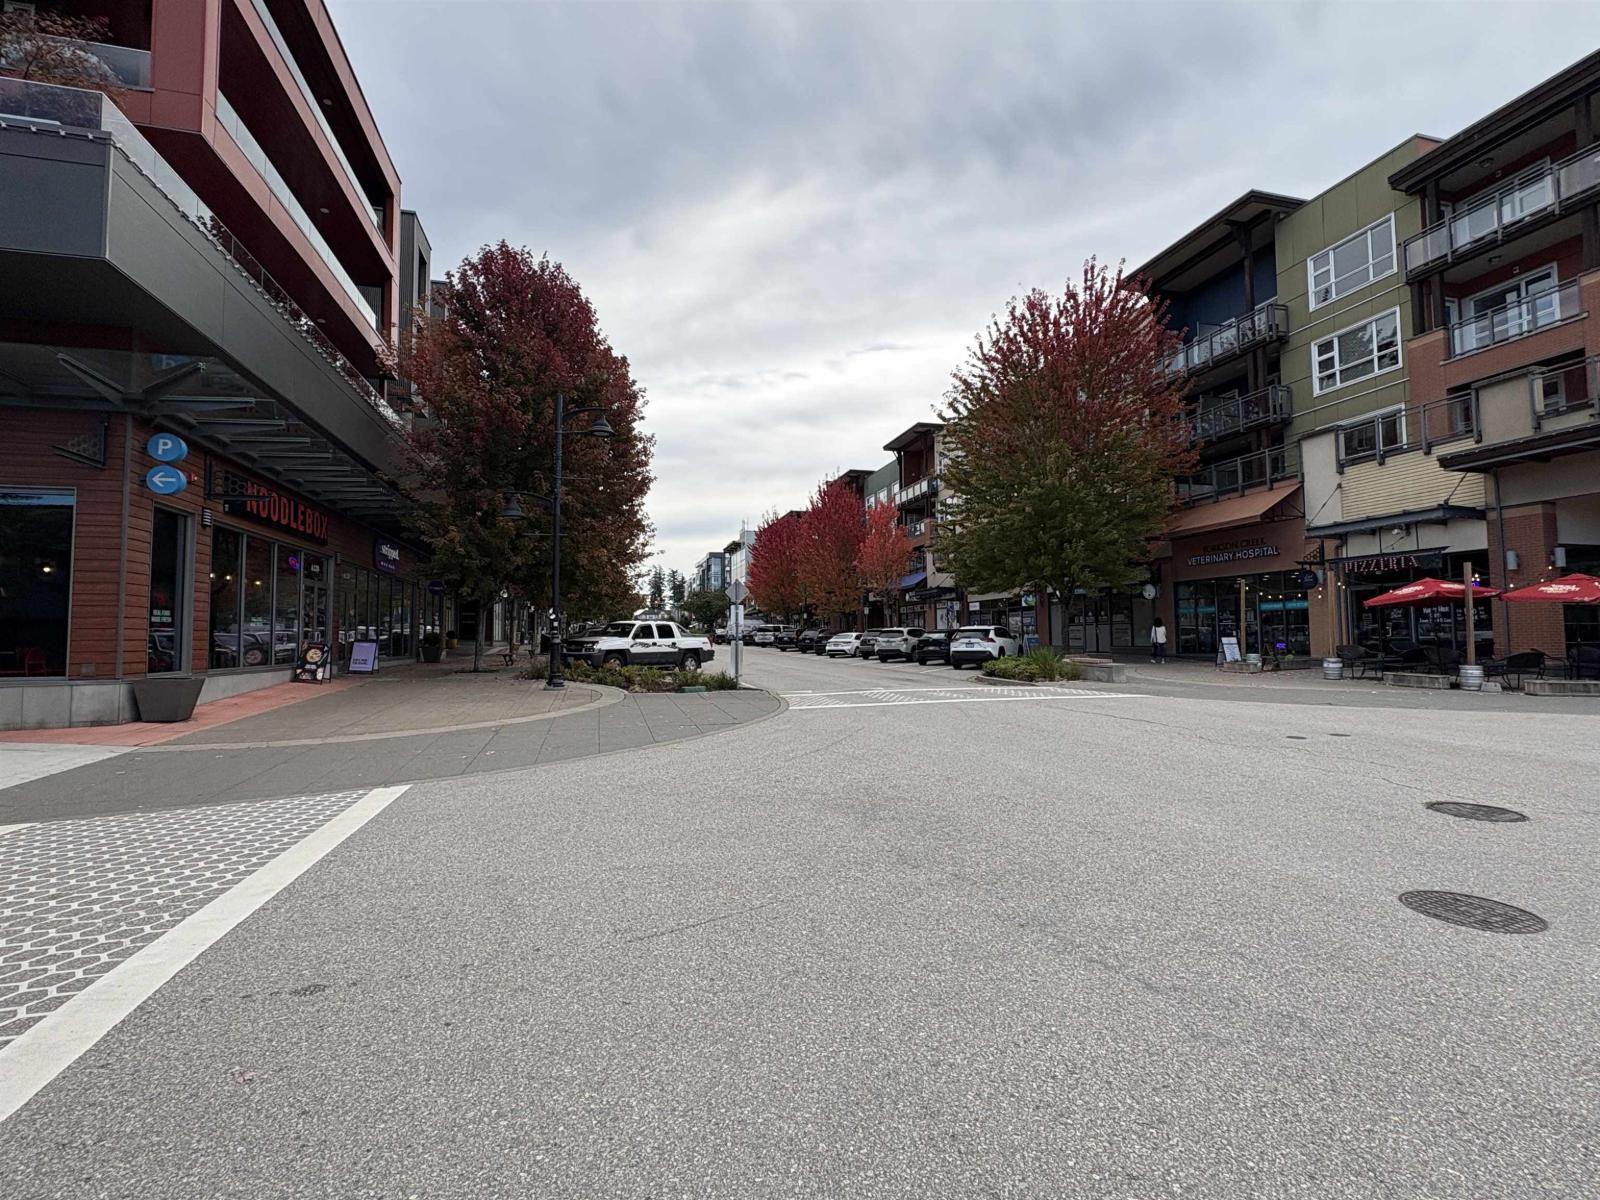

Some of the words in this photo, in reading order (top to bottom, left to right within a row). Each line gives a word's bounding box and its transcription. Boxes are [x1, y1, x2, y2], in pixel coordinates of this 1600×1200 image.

[157, 438, 173, 455] P
[245, 481, 328, 539] NOODLEBOX
[1187, 552, 1233, 566] VETERINARY
[1235, 545, 1280, 560] HOSPITAL
[1344, 555, 1419, 573] PIZZERIA
